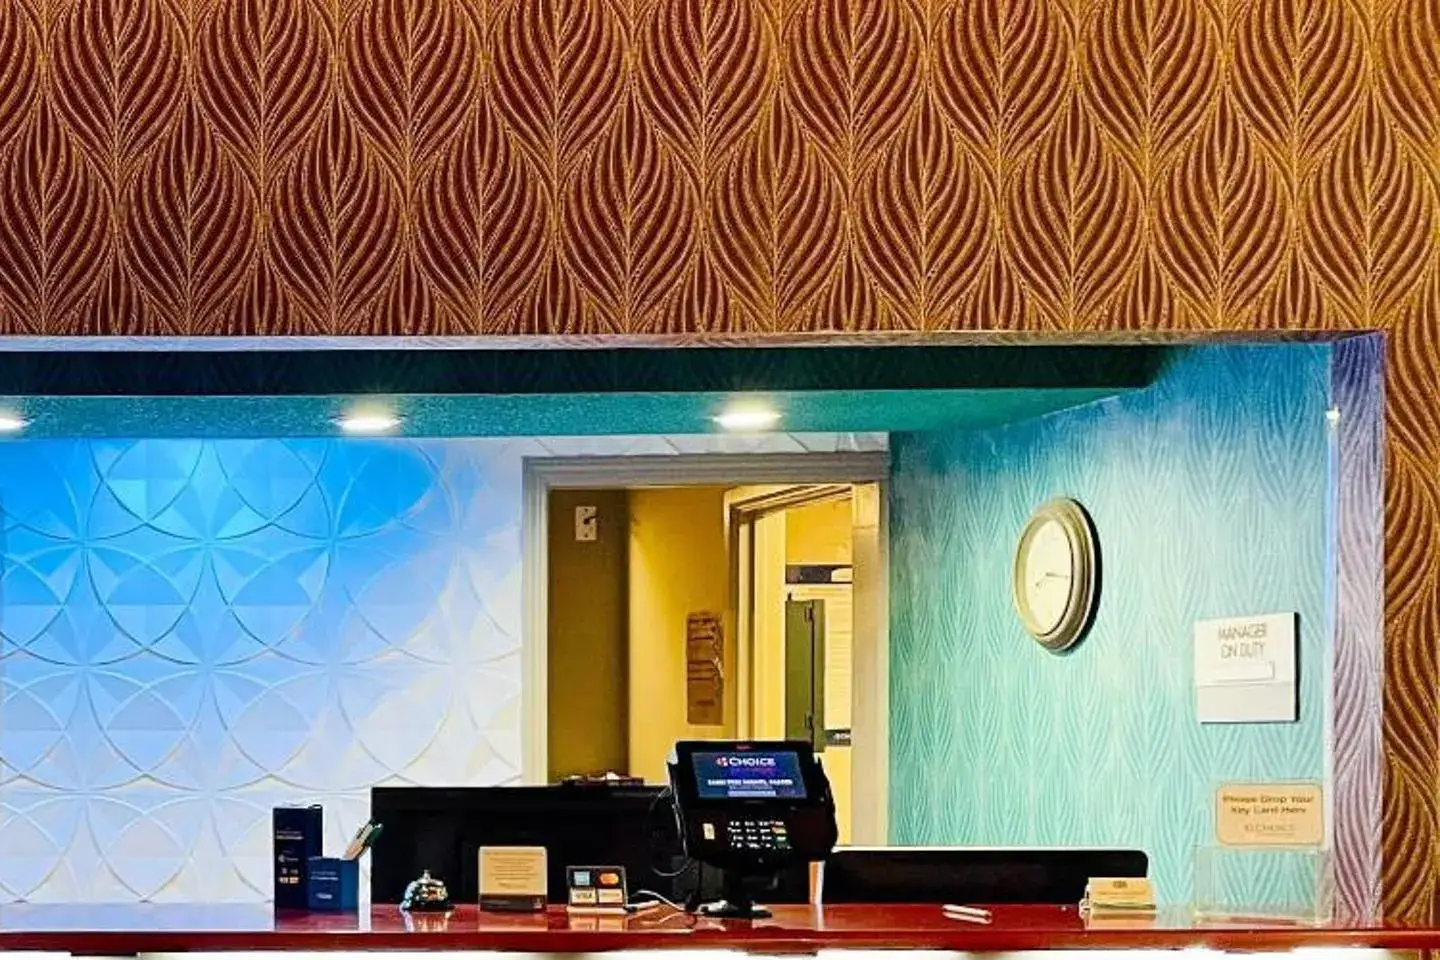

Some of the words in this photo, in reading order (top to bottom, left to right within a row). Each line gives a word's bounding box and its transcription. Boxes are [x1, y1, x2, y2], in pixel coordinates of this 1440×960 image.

[1218, 621, 1266, 640] MANAGER
[1220, 642, 1237, 659] ON
[1240, 640, 1265, 658] DUTY
[728, 757, 776, 767] CHOICE
